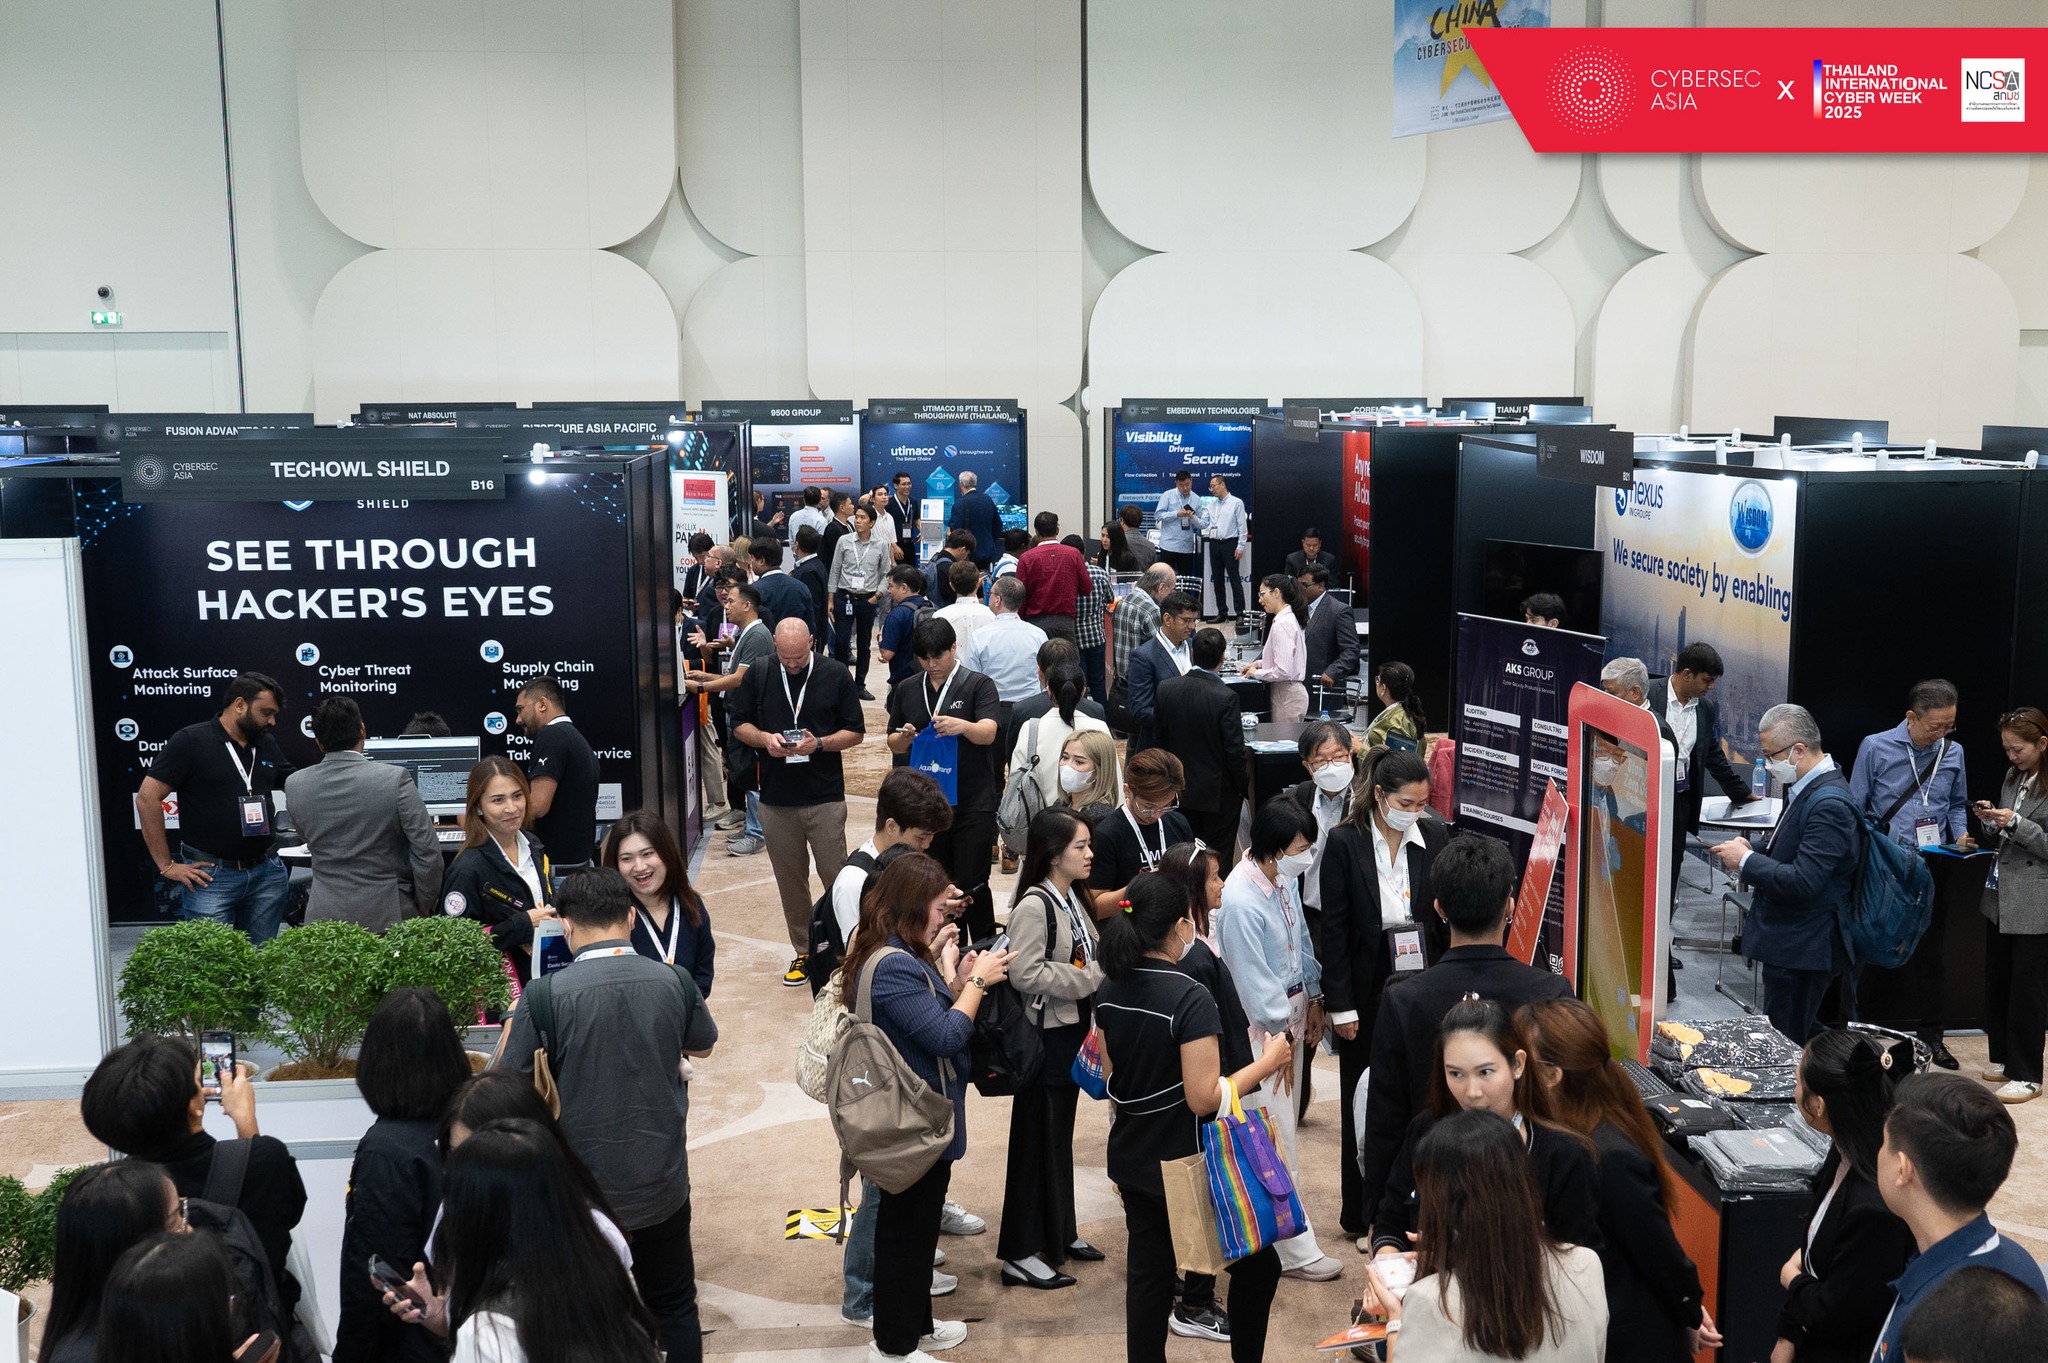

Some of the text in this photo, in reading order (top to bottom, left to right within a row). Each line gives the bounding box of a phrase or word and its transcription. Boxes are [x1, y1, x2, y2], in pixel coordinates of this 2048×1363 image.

[422, 411, 457, 419] ABSOLUTE
[770, 409, 821, 417] 9500 GROUP
[1166, 407, 1260, 415] EMBEDWAY TECHNOLOGIES
[1497, 406, 1522, 414] TIANJI
[913, 412, 1010, 421] THROUGHWAVE (THAILAND)
[165, 426, 203, 436] FUSION
[586, 423, 611, 433] ASIA
[614, 422, 657, 433] PACIFIC
[1125, 431, 1182, 445] Visibility
[1168, 445, 1195, 453] Drives
[1183, 453, 1239, 467] Security
[1579, 449, 1605, 465] WISDOM
[172, 462, 218, 471] CYBERSEC
[270, 460, 450, 478] TECHOWL SHIELD
[173, 472, 193, 480] ASIA
[471, 480, 494, 490] B16
[1630, 480, 1664, 510] nexus
[357, 499, 409, 509] SHIELD
[206, 537, 537, 572] SEE THROUGH
[1613, 537, 1791, 623] We secure society by enabling
[197, 585, 555, 621] HACKER'S EYES
[132, 667, 238, 679] Attack Surface
[318, 664, 412, 679] Cyber Threat
[502, 660, 594, 676] Supply Chain
[1505, 662, 1554, 681] AKS GROUP
[134, 683, 212, 698] Monitoring
[320, 680, 397, 695] Monitoring
[1466, 708, 1487, 717] AUDITING
[1534, 722, 1562, 735] CONSULTING
[138, 740, 168, 752] Dar
[1464, 746, 1507, 761] INCIDENT RESPONSE
[1533, 762, 1550, 773] DIGITAL
[1484, 811, 1504, 822] COURSES
